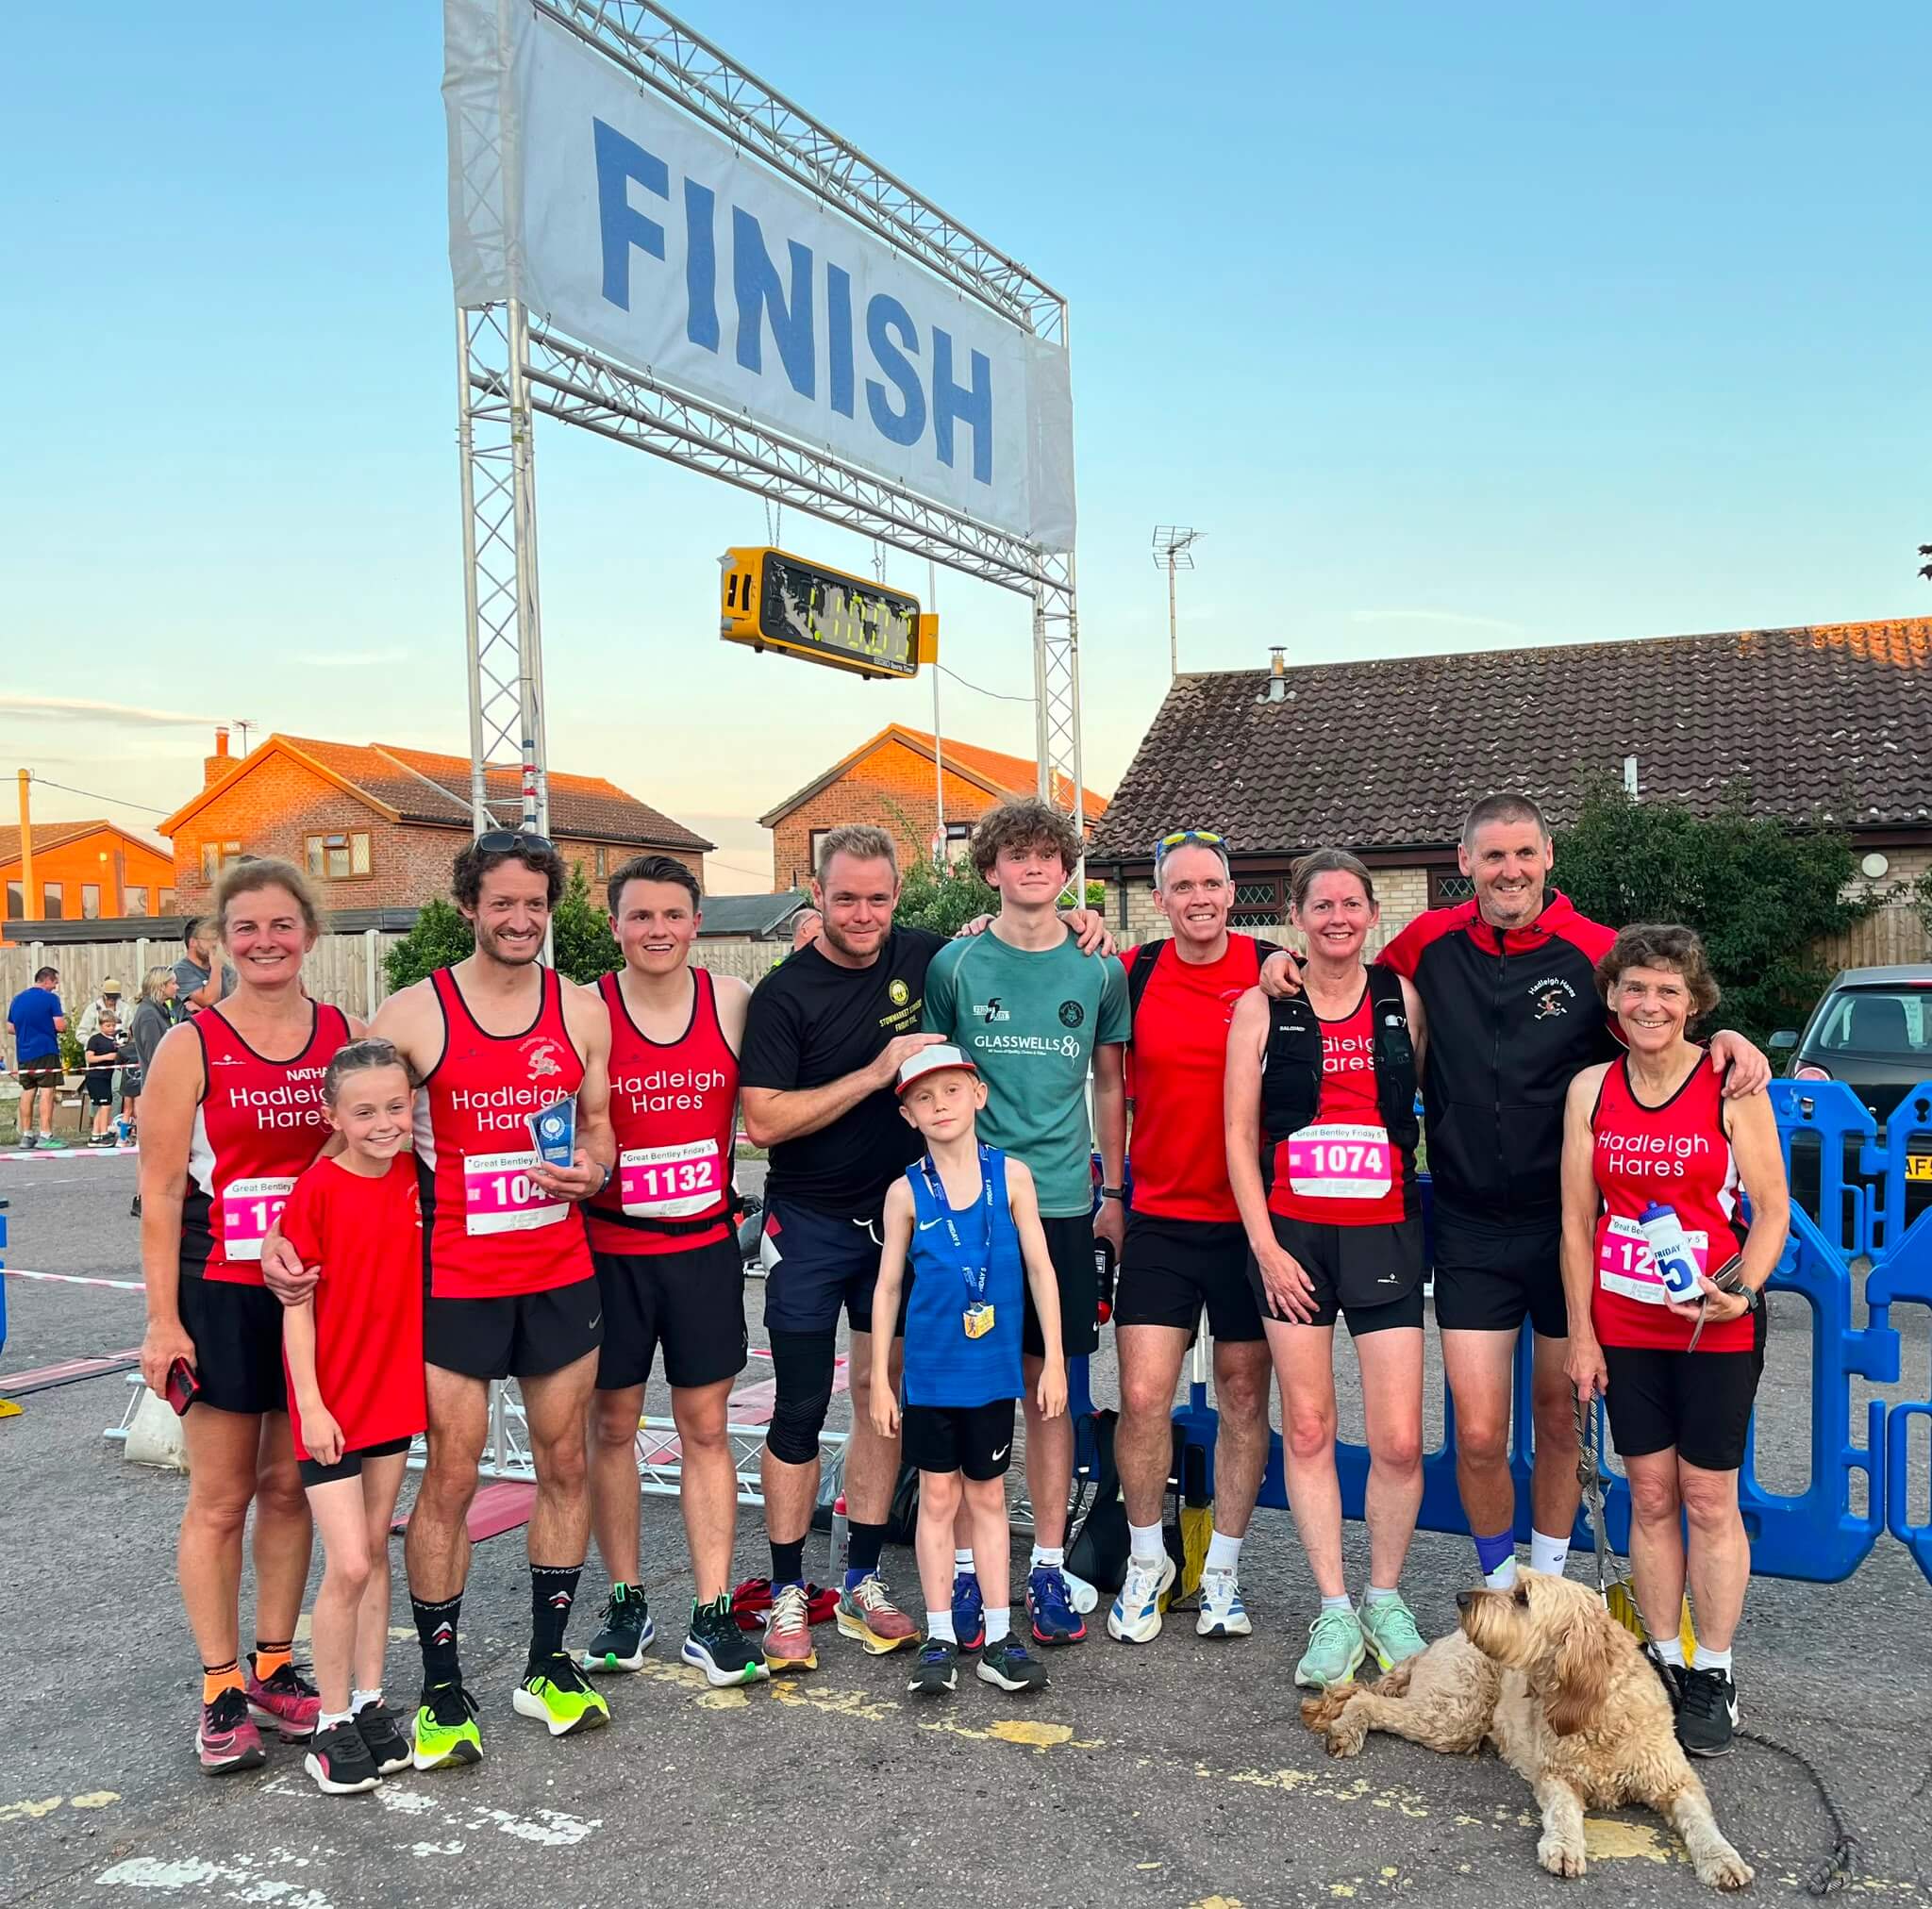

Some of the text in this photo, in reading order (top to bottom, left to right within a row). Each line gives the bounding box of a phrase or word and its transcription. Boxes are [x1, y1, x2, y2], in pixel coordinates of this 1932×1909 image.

[592, 116, 992, 487] FINISH
[974, 1035, 1080, 1058] GLASSWELLS 80
[1323, 1055, 1375, 1072] ares
[610, 1069, 725, 1095] Hadleigh
[229, 1084, 327, 1108] Hadlei
[452, 1085, 569, 1110] Hadleigh
[631, 1093, 704, 1114] Hares
[477, 1110, 530, 1132] Har
[1297, 1129, 1318, 1137] Great
[1321, 1128, 1349, 1137] Bentley
[1352, 1129, 1375, 1138] Friday
[1597, 1130, 1709, 1157] Hadleigh
[474, 1160, 498, 1169] Great
[500, 1156, 533, 1167] Bentley
[651, 1151, 681, 1160] Bentley
[683, 1146, 706, 1155] Friday
[1310, 1145, 1383, 1172] 1074
[1609, 1154, 1685, 1176] Hares
[232, 1183, 291, 1193] Great Bentley
[491, 1174, 555, 1205] 104
[642, 1161, 713, 1195] 1132
[1655, 1244, 1681, 1259] FRIDAY
[1657, 1258, 1693, 1292] 5
